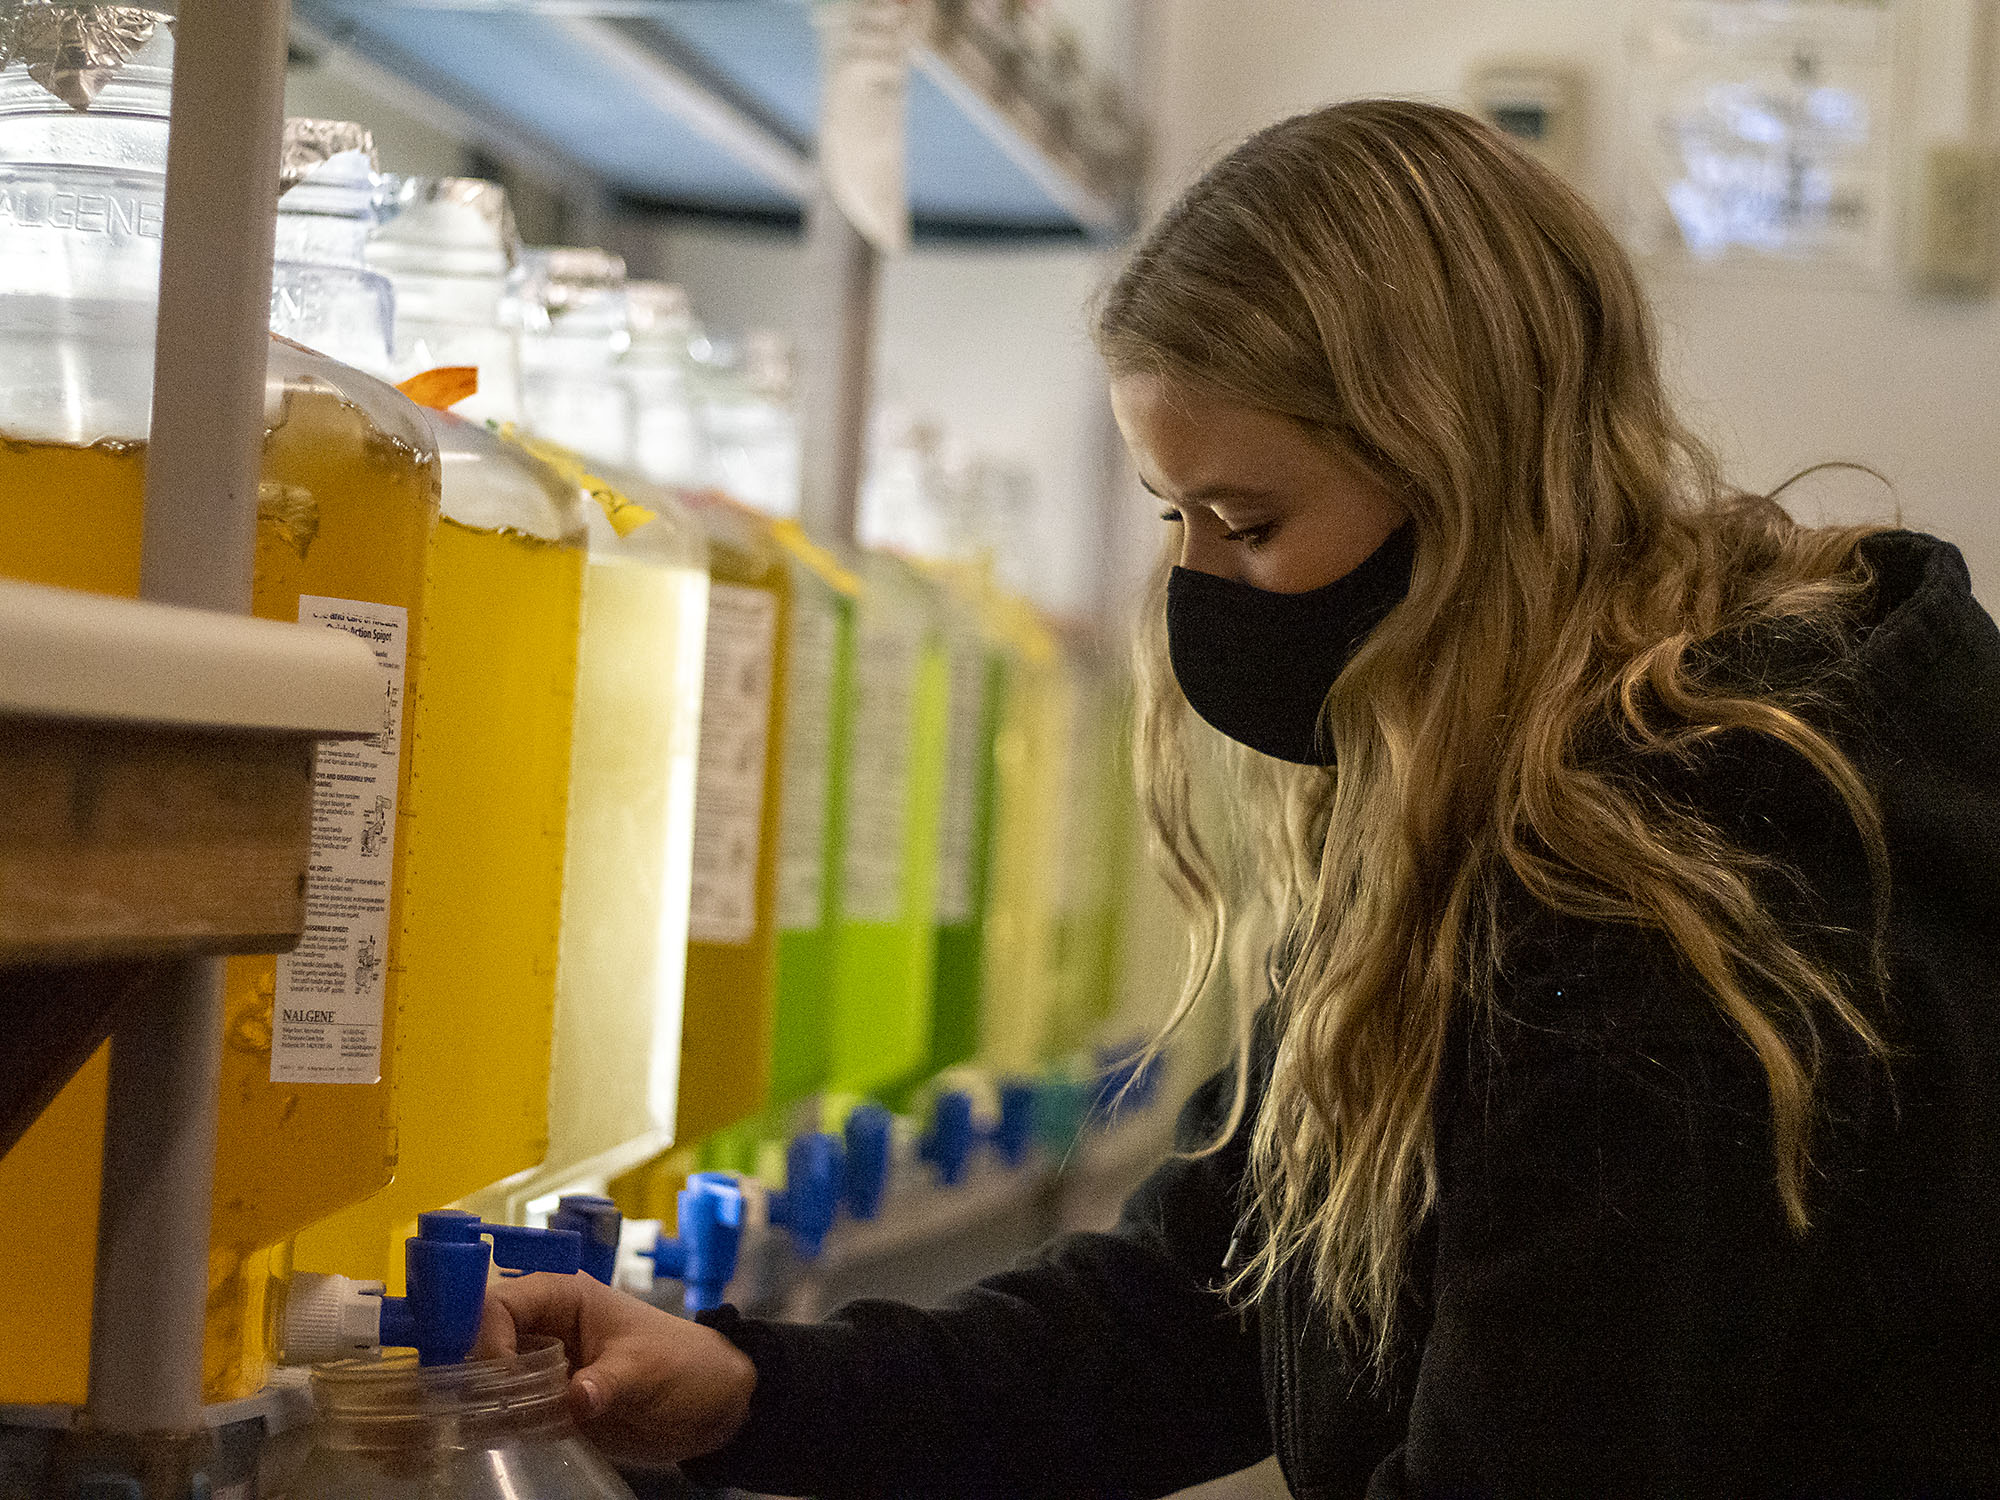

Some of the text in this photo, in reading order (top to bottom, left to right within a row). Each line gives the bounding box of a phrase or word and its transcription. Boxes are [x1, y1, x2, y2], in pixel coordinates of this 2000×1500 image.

[0, 190, 165, 239] ALGENE
[373, 629, 392, 643] Spigot
[283, 1009, 335, 1023] NALGENE
